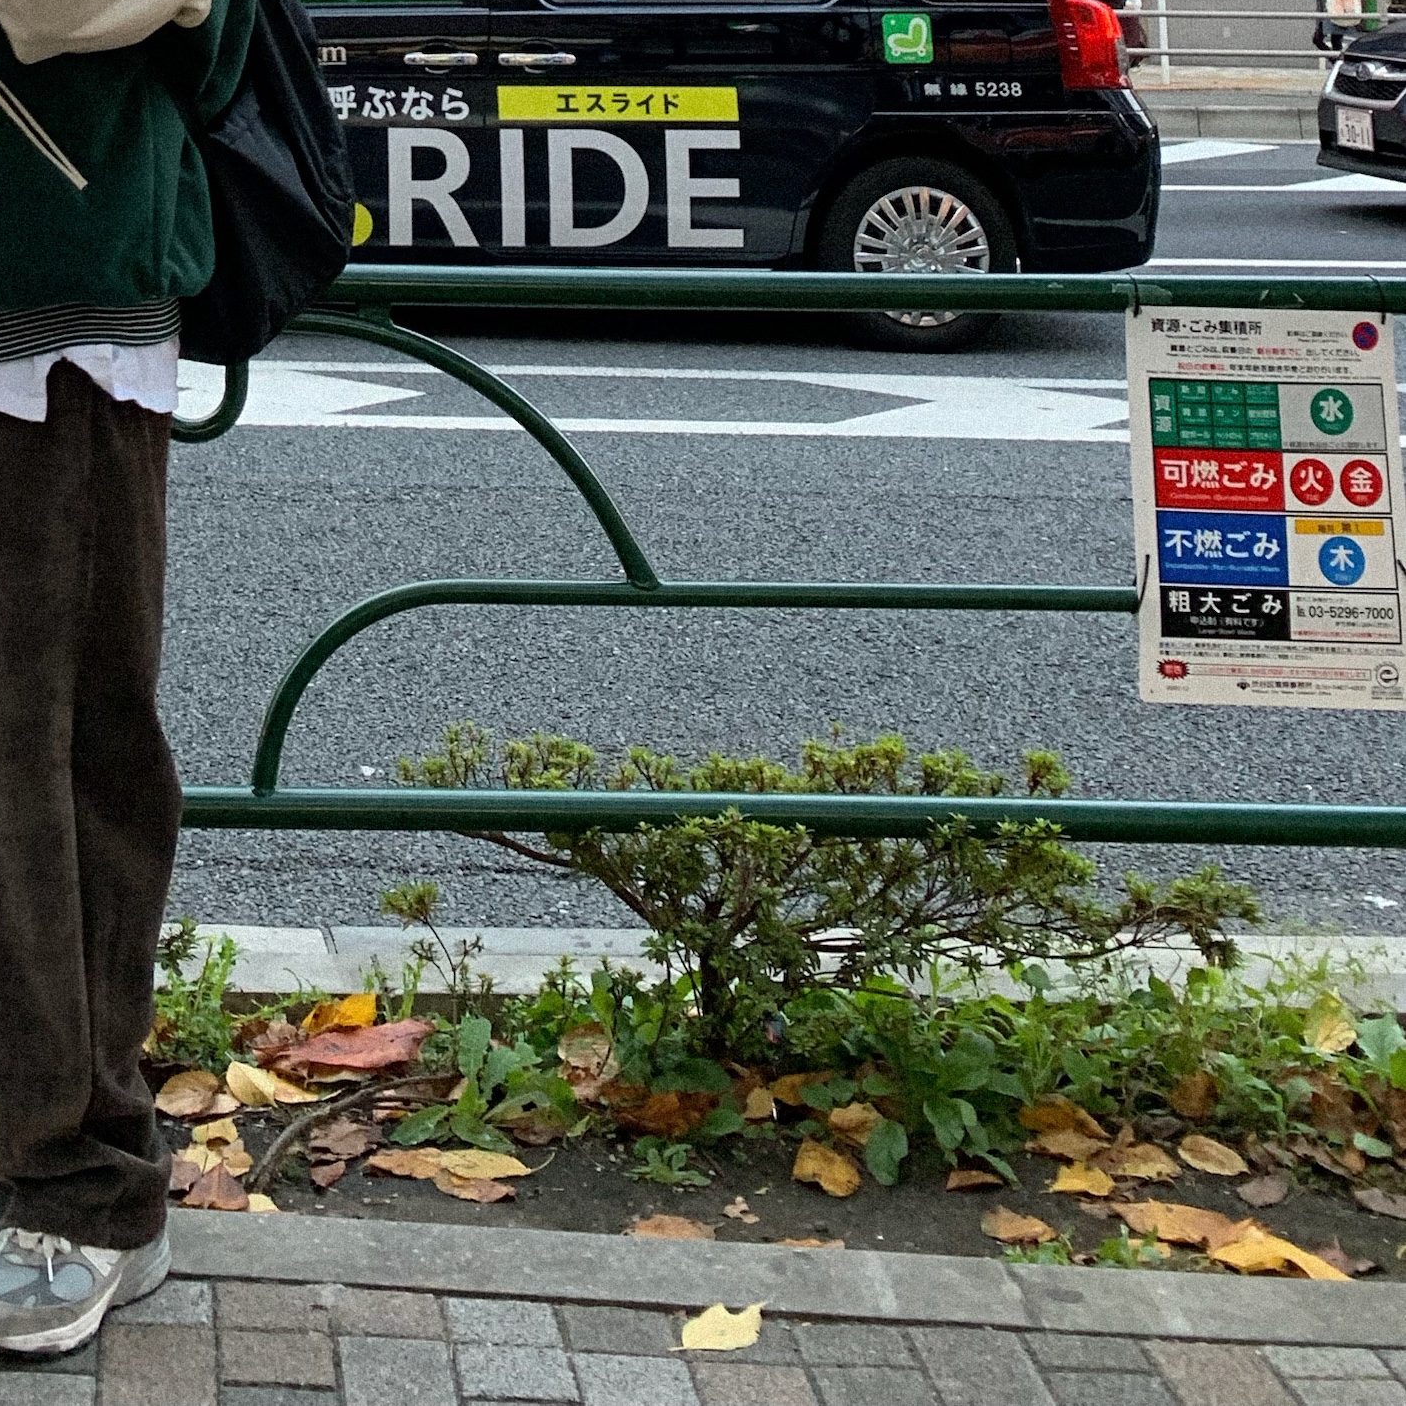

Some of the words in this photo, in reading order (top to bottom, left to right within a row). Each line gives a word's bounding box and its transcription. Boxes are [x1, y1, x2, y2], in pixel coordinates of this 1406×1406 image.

[317, 45, 347, 66] m
[975, 82, 1022, 97] 5238
[556, 92, 680, 115] エスライド
[1319, 396, 1344, 422] 水
[1160, 459, 1278, 490] 可燃ごみ
[1299, 466, 1325, 492] 火
[1349, 466, 1374, 493] 金
[1164, 529, 1281, 560] 不燃ごみ
[1329, 545, 1355, 571] 木
[1169, 590, 1283, 615] 粗大ごみ
[1308, 606, 1395, 620] 03-5296-7000
